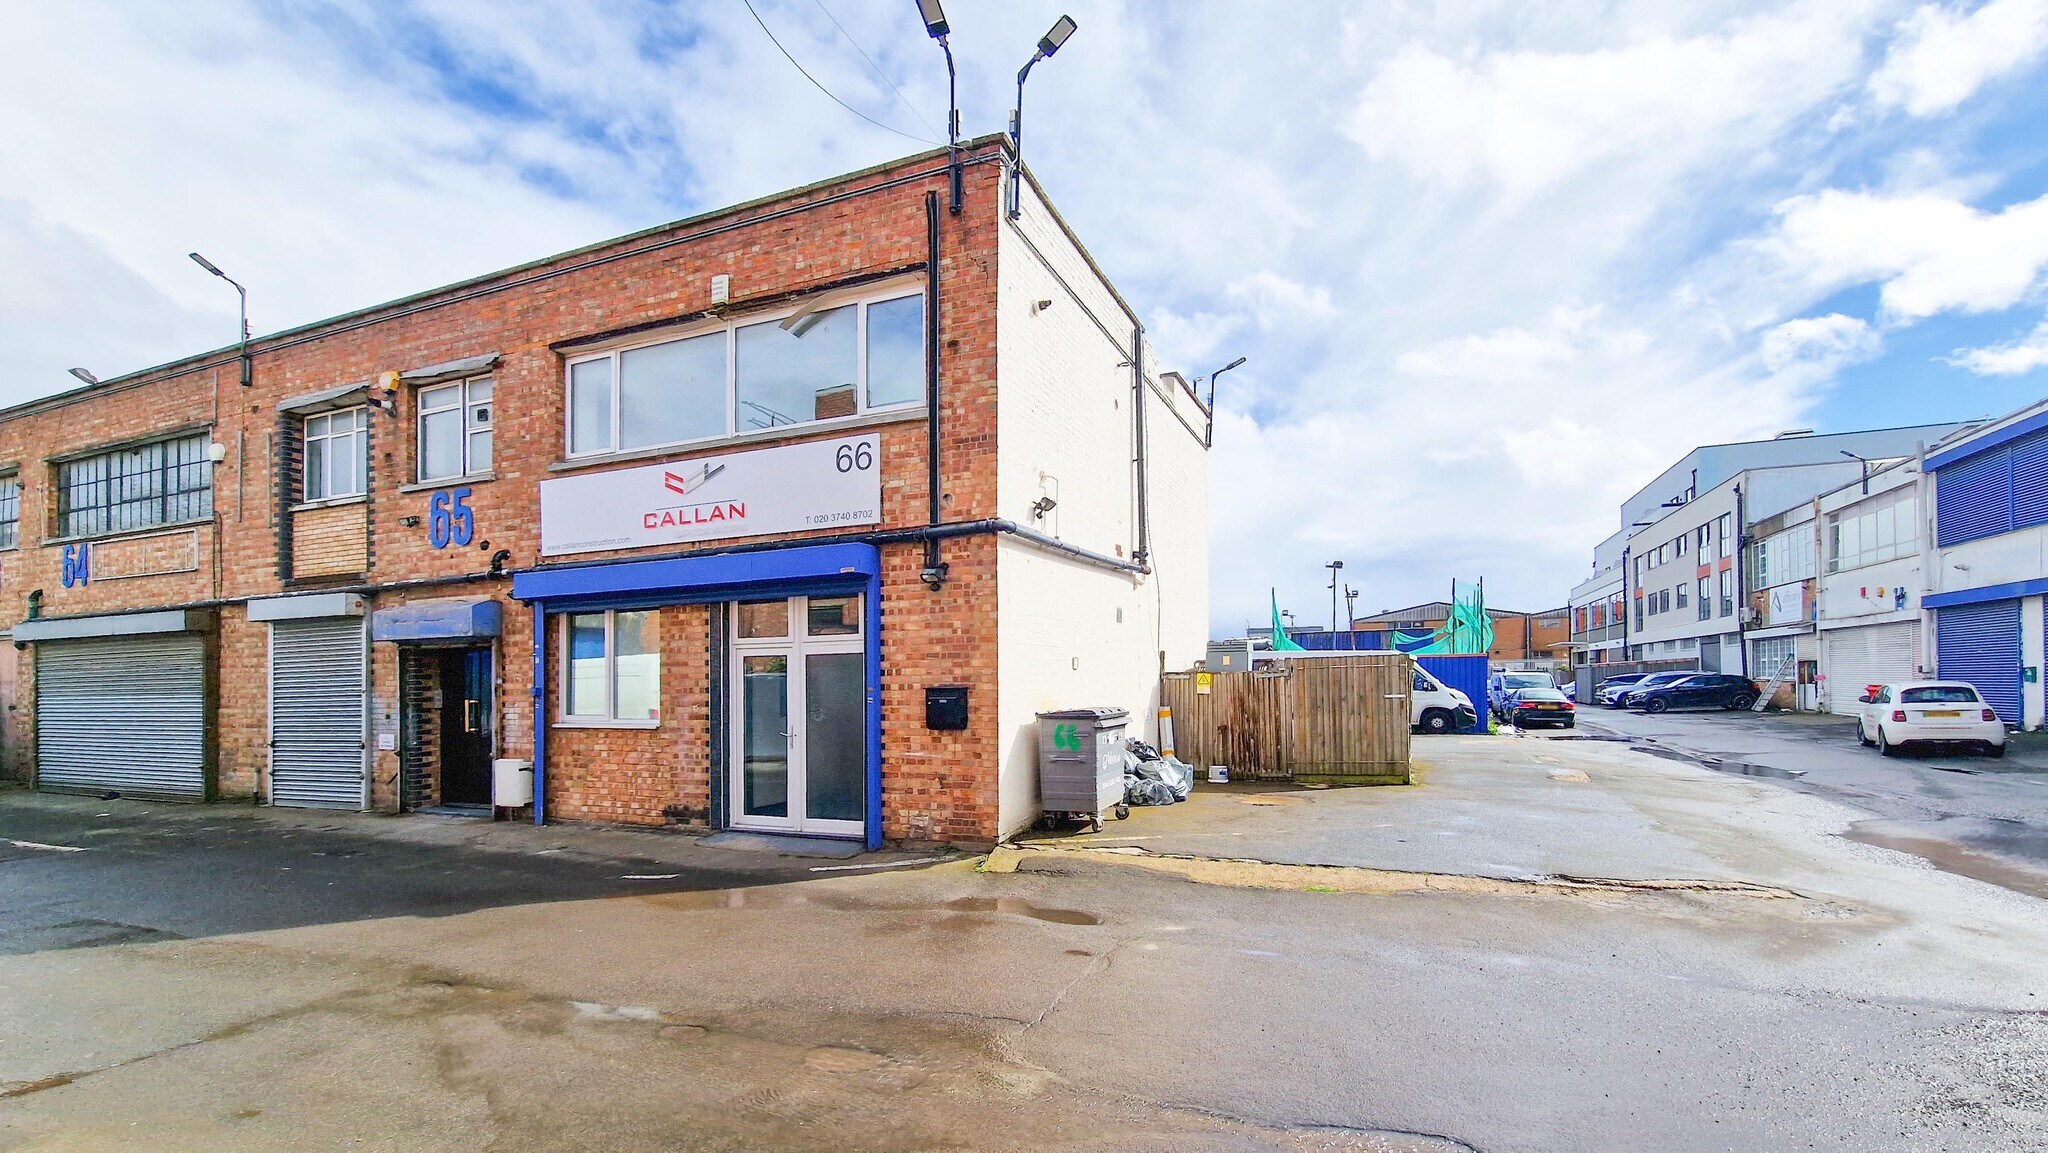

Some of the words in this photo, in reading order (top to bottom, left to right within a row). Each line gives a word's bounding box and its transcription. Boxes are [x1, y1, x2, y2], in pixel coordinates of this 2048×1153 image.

[836, 441, 873, 473] 66
[430, 488, 474, 549] 65
[643, 502, 747, 529] CALLAN
[805, 516, 812, 524] T:
[813, 514, 828, 524] 020
[830, 512, 851, 522] 3740
[852, 510, 873, 520] 8702
[546, 537, 632, 551] www.callanconstruction.com
[62, 543, 88, 588] 64
